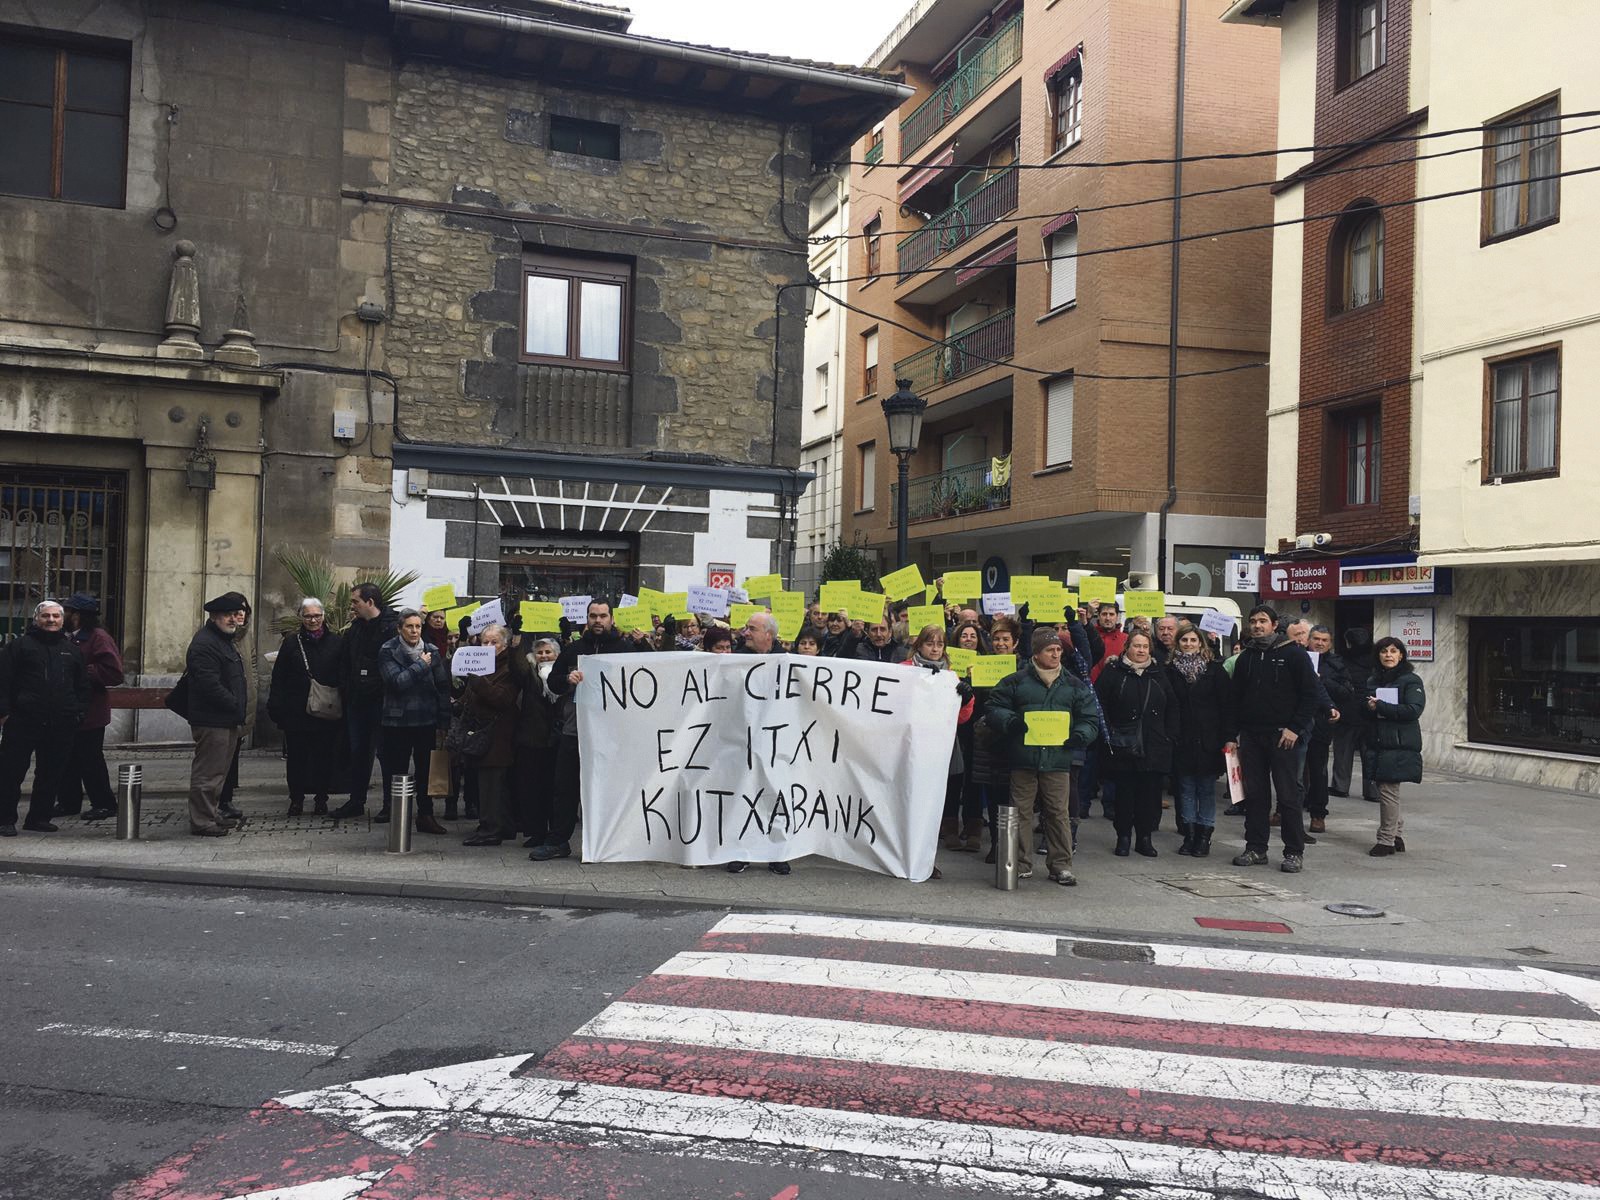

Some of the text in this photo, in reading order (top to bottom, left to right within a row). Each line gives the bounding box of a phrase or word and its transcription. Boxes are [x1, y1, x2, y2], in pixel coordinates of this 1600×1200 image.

[1290, 566, 1327, 578] Tabakoak
[712, 574, 732, 589] 22
[1290, 580, 1323, 591] Tabacos
[1403, 628, 1421, 636] BOTE
[600, 662, 900, 715] NO AL CIERRE
[657, 719, 840, 773] EZ ITXI
[641, 783, 875, 846] KUTXABANK
